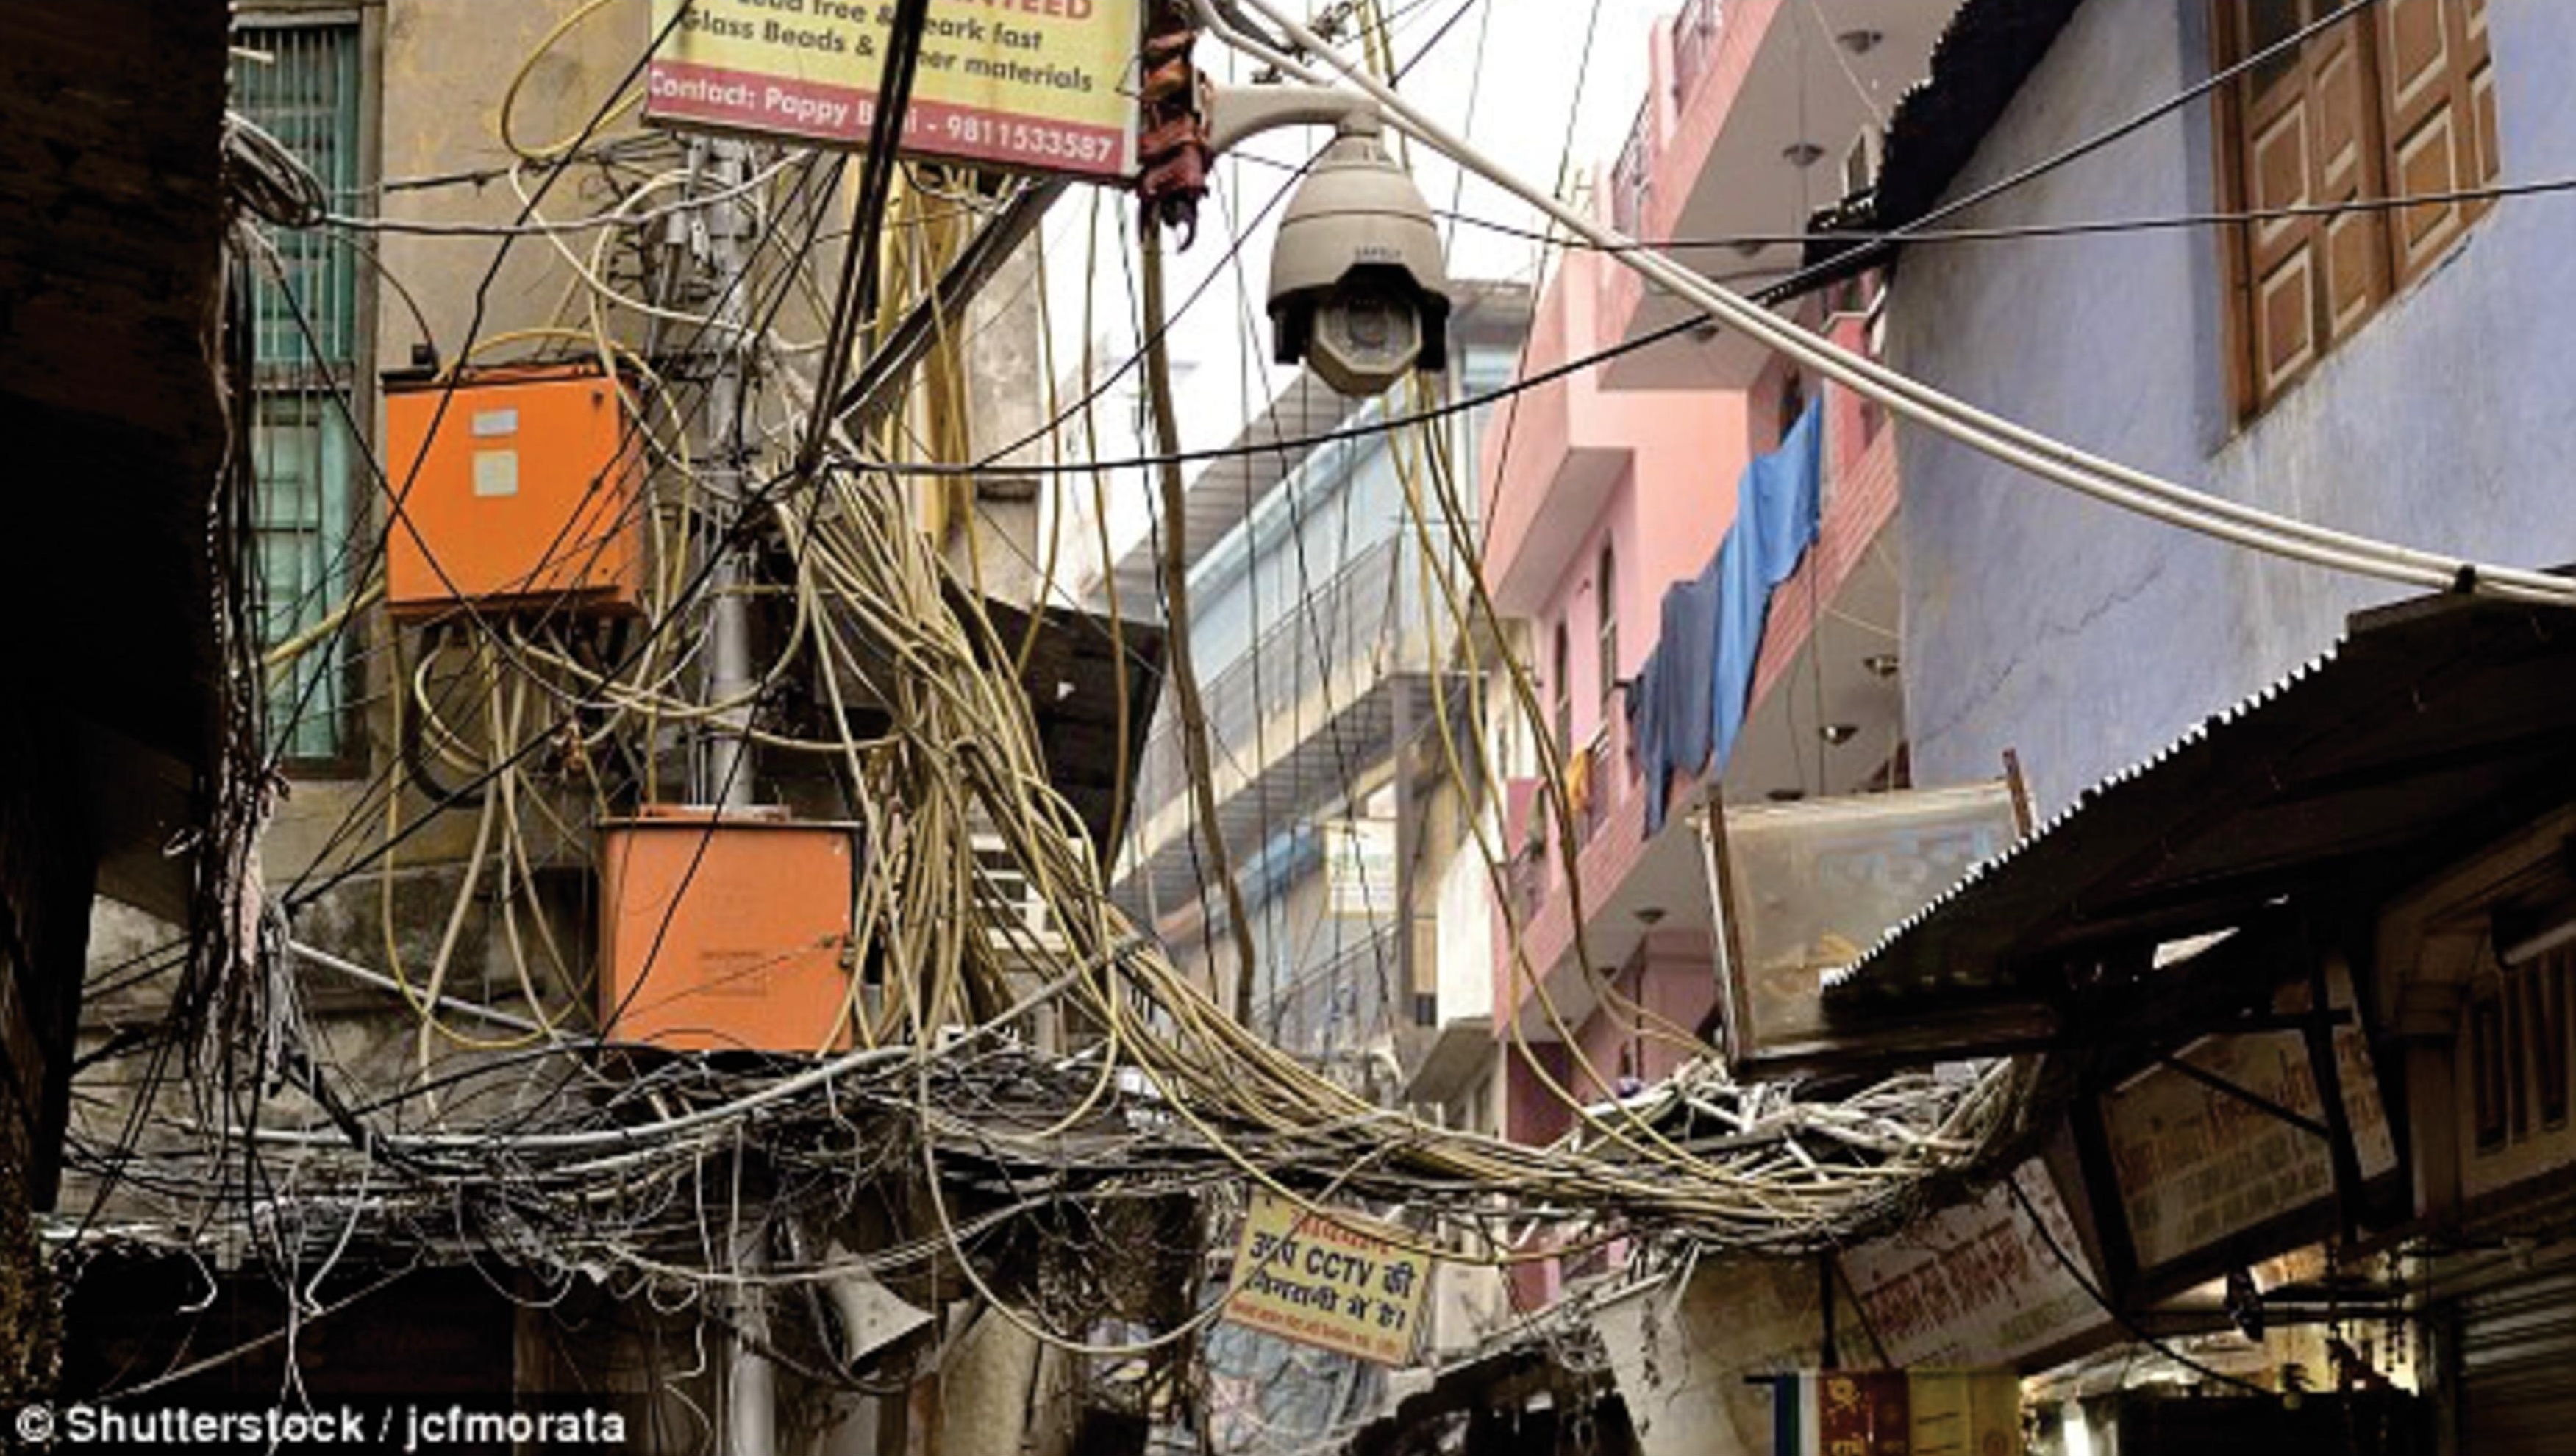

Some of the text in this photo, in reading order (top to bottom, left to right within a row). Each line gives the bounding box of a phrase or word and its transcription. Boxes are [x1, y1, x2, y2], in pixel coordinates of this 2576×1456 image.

[681, 8, 754, 40] Glass
[763, 18, 845, 52] Beads
[855, 35, 874, 57] &
[963, 54, 1093, 93] materials
[813, 0, 867, 23] free
[993, 21, 1043, 51] fast
[650, 70, 756, 110] Contact:
[764, 86, 849, 127] Pappy
[946, 115, 1113, 163] 9811533587
[1306, 1245, 1375, 1288] CCTV
